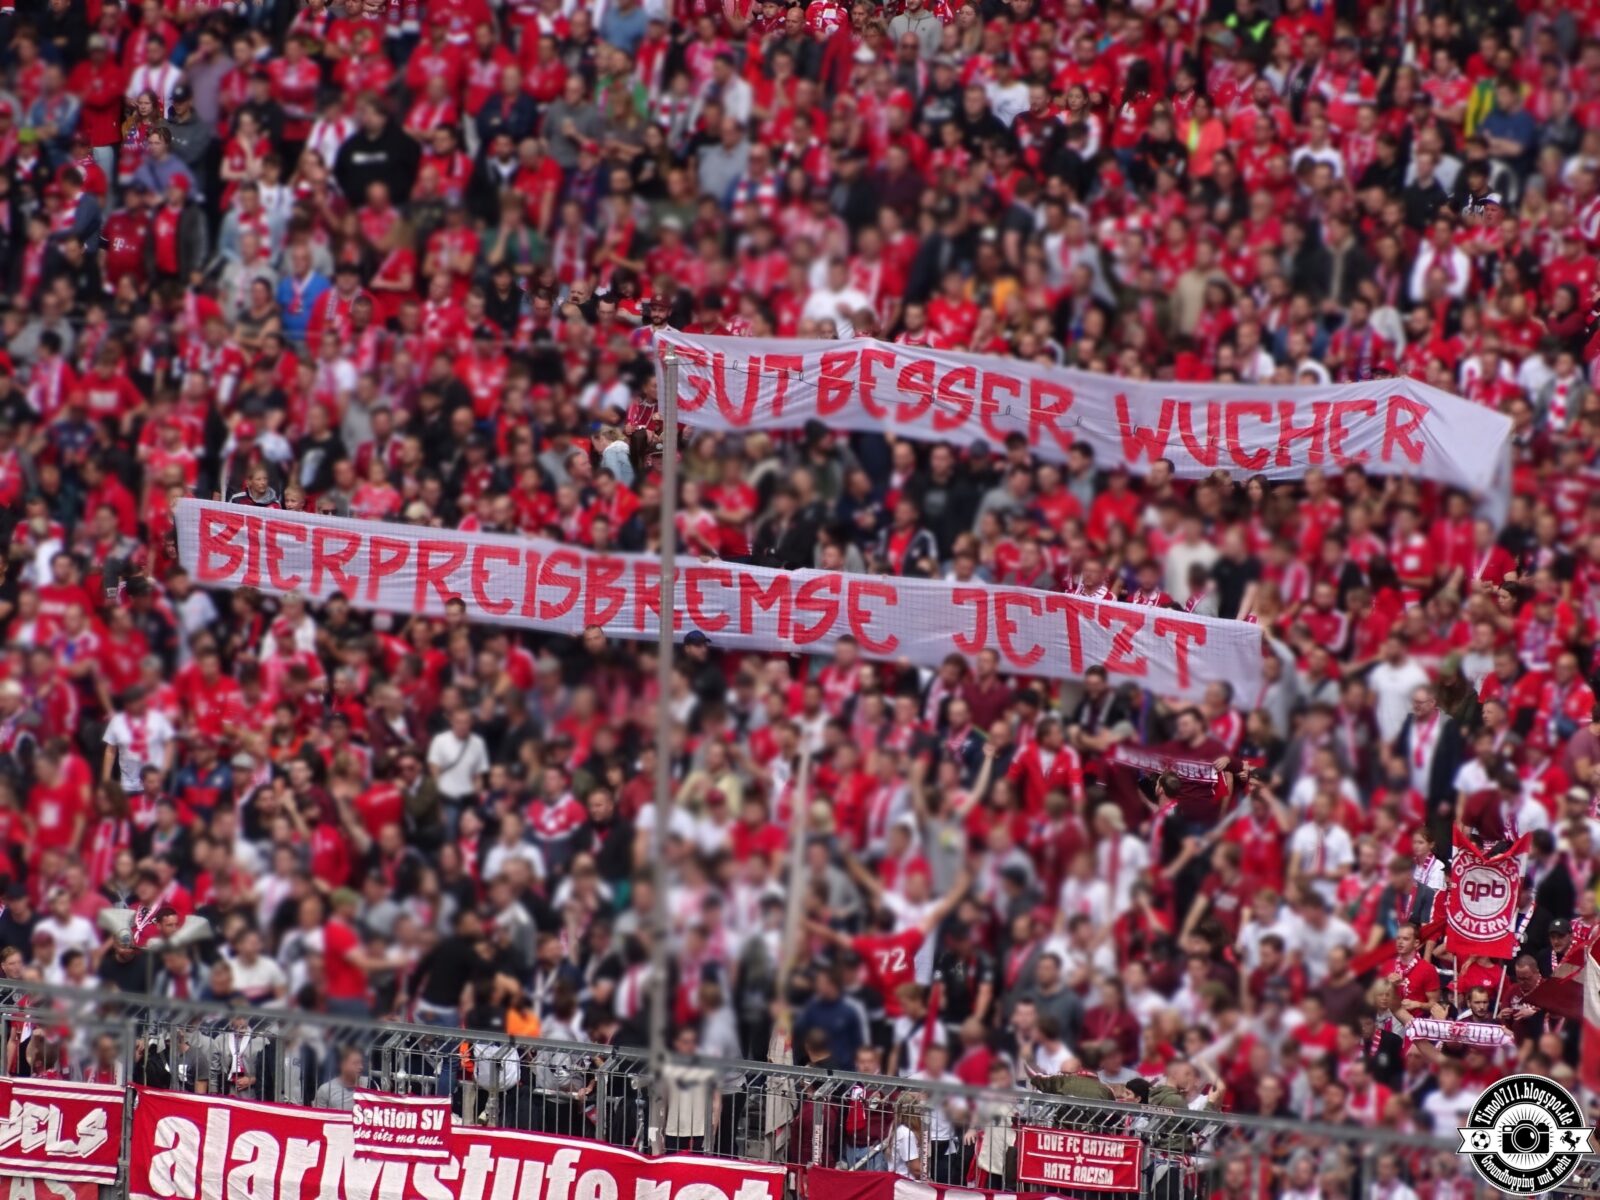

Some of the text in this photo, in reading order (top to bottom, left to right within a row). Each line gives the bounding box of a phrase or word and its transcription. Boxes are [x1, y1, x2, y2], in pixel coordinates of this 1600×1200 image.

[658, 339, 1430, 471] GUT BESSER WUCHER
[196, 508, 1207, 689] BIERPREISBREMSE JETZT
[1463, 880, 1507, 902] qpb
[1453, 911, 1509, 933] BAYERN
[874, 946, 907, 975] 72
[353, 1104, 446, 1131] Sektion SV
[1038, 1133, 1125, 1159] LOVE FC BAYERN
[1044, 1162, 1114, 1185] HATE RACISM
